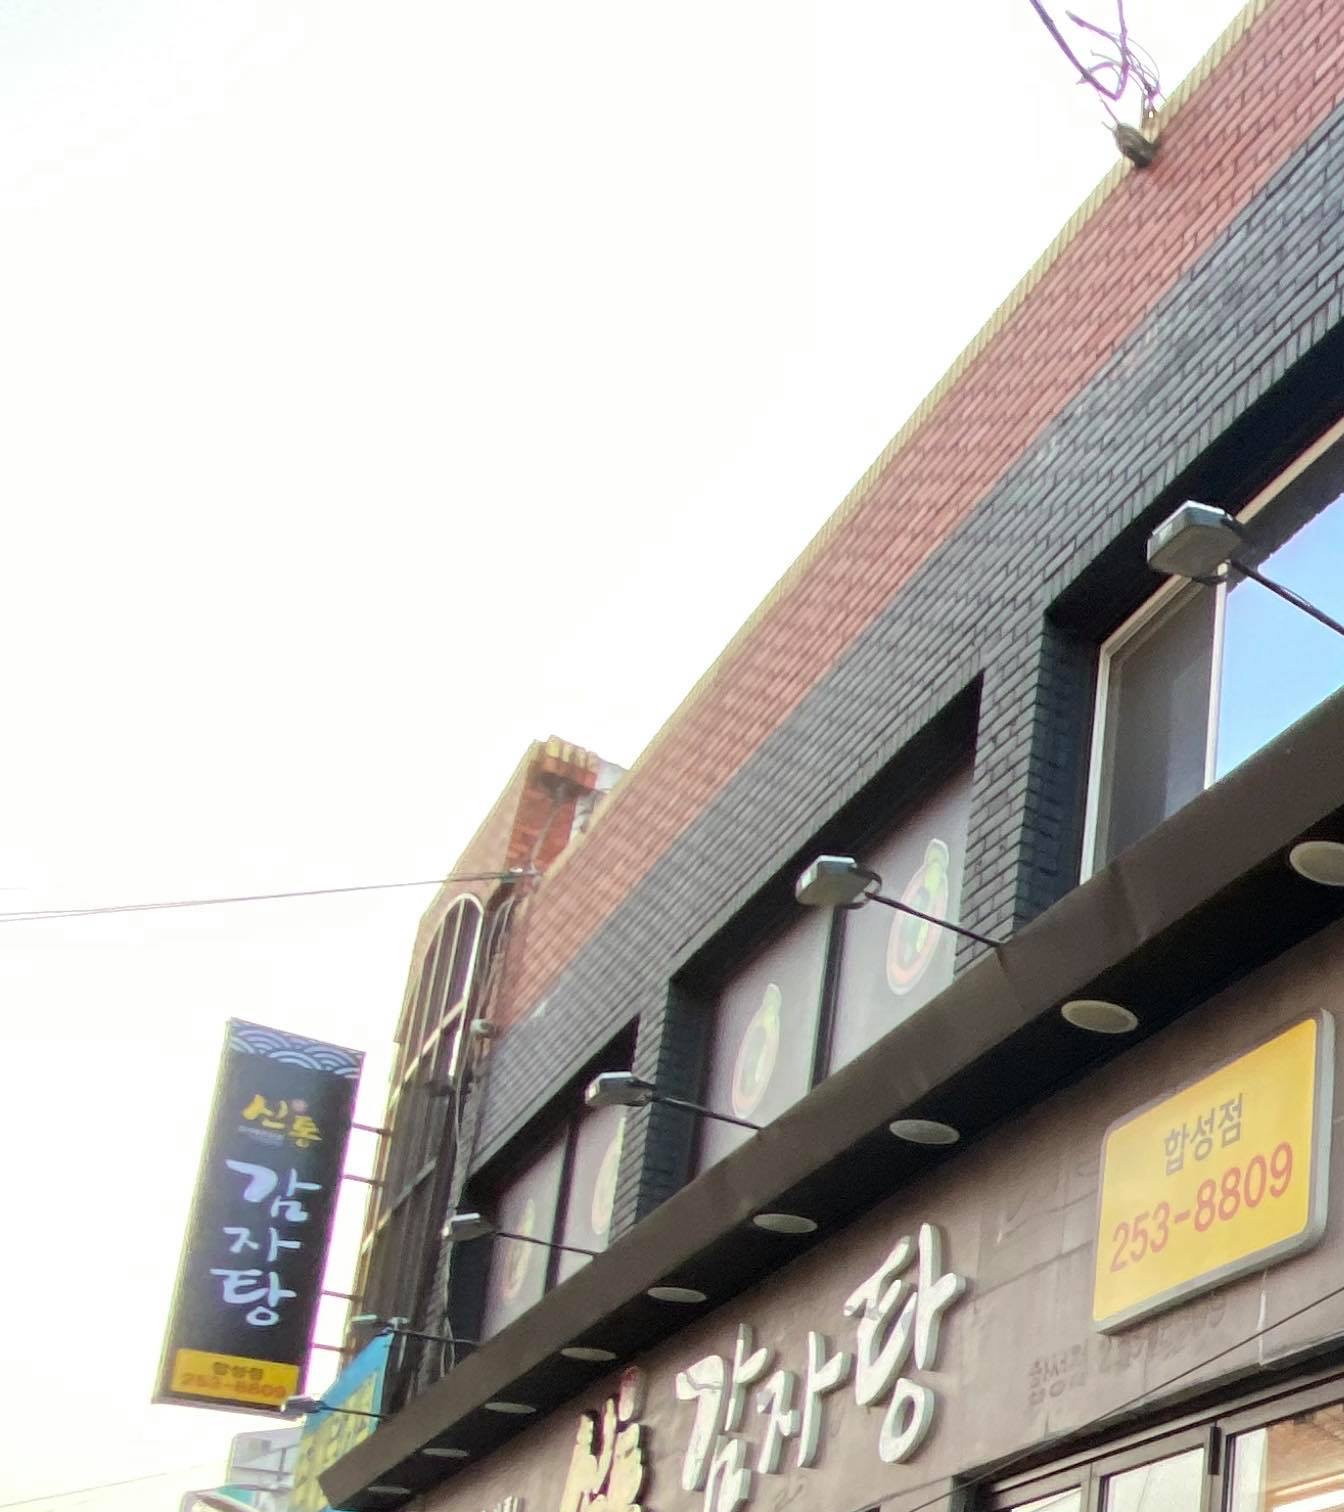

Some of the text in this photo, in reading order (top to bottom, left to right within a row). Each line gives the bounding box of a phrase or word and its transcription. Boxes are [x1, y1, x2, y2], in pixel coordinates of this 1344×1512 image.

[1163, 1092, 1246, 1176] 합성점
[209, 1158, 322, 1327] 감자탕
[1110, 1141, 1294, 1272] 253-8809
